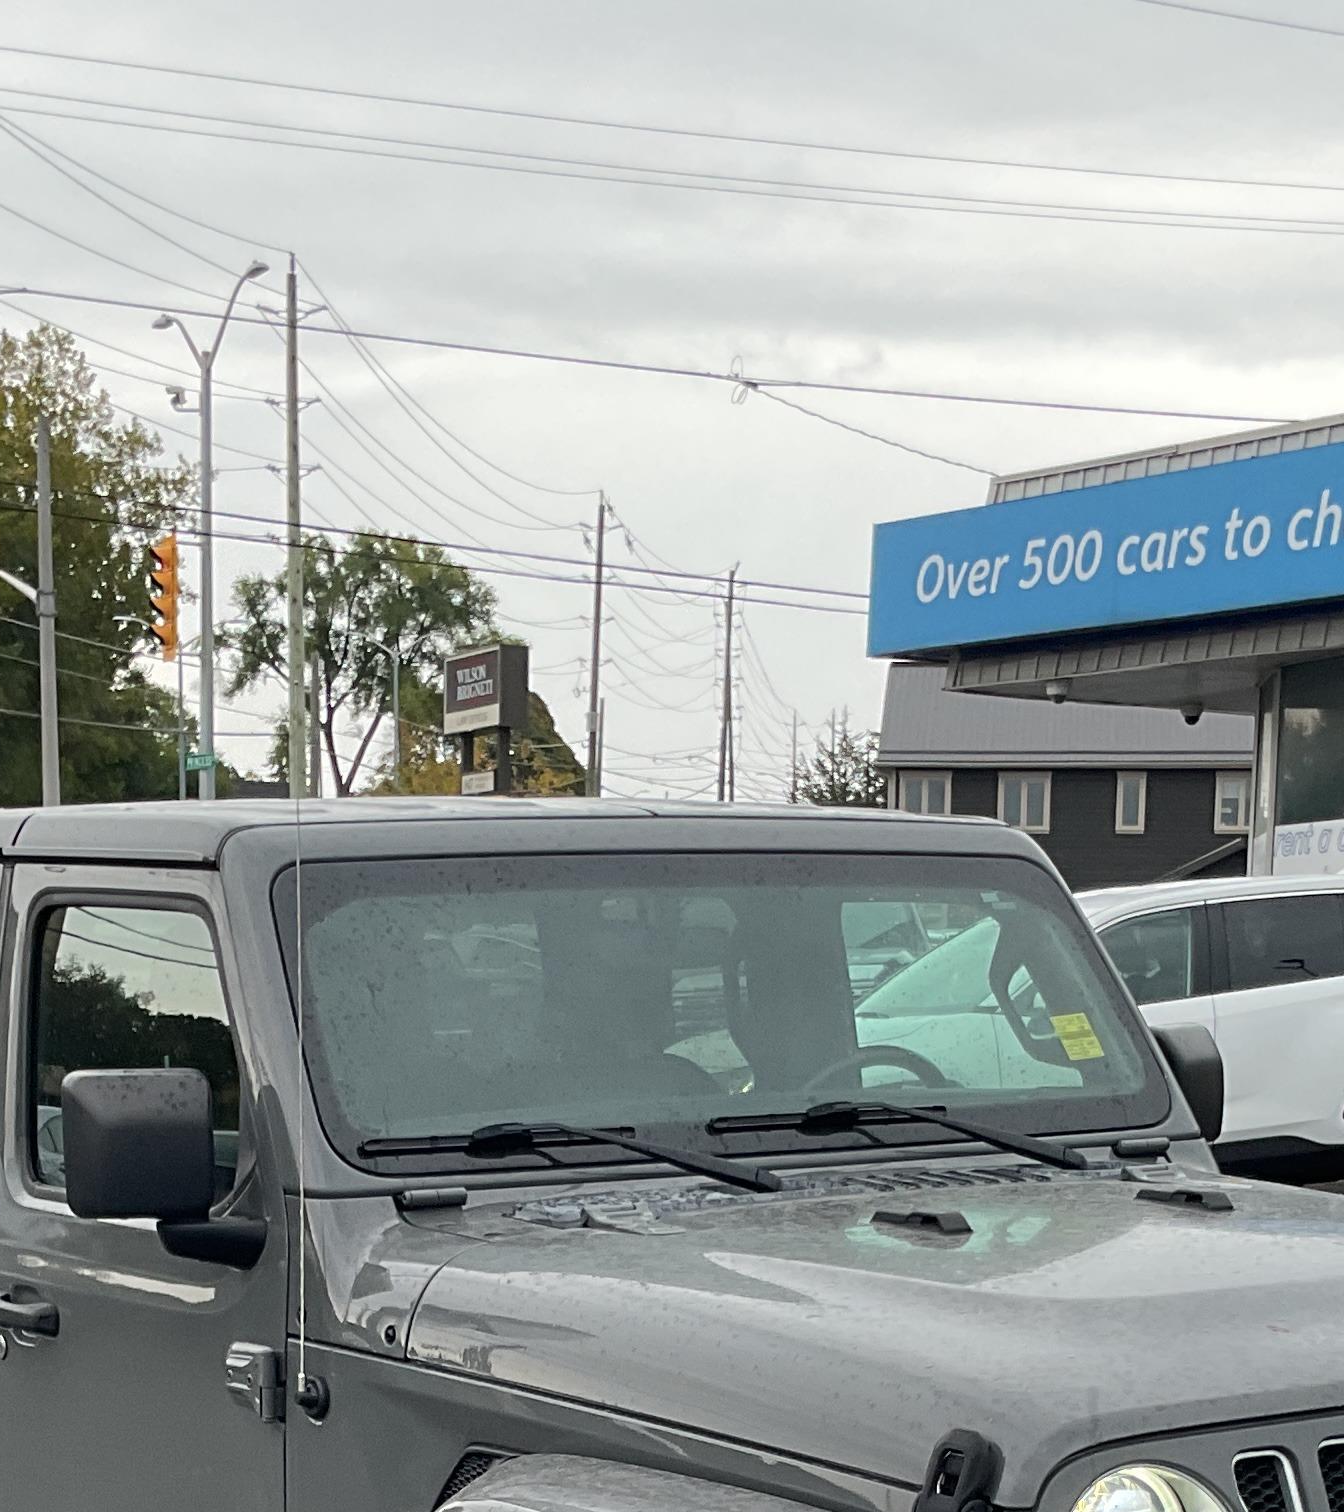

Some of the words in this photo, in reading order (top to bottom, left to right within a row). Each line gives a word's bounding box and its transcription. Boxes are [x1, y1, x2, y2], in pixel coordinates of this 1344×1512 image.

[916, 554, 1010, 603] Over
[1018, 529, 1103, 589] 500
[1116, 525, 1209, 575] cars
[1225, 507, 1271, 561] to
[456, 664, 486, 684] WILSON
[1275, 823, 1314, 857] rent
[1318, 828, 1333, 854] a
